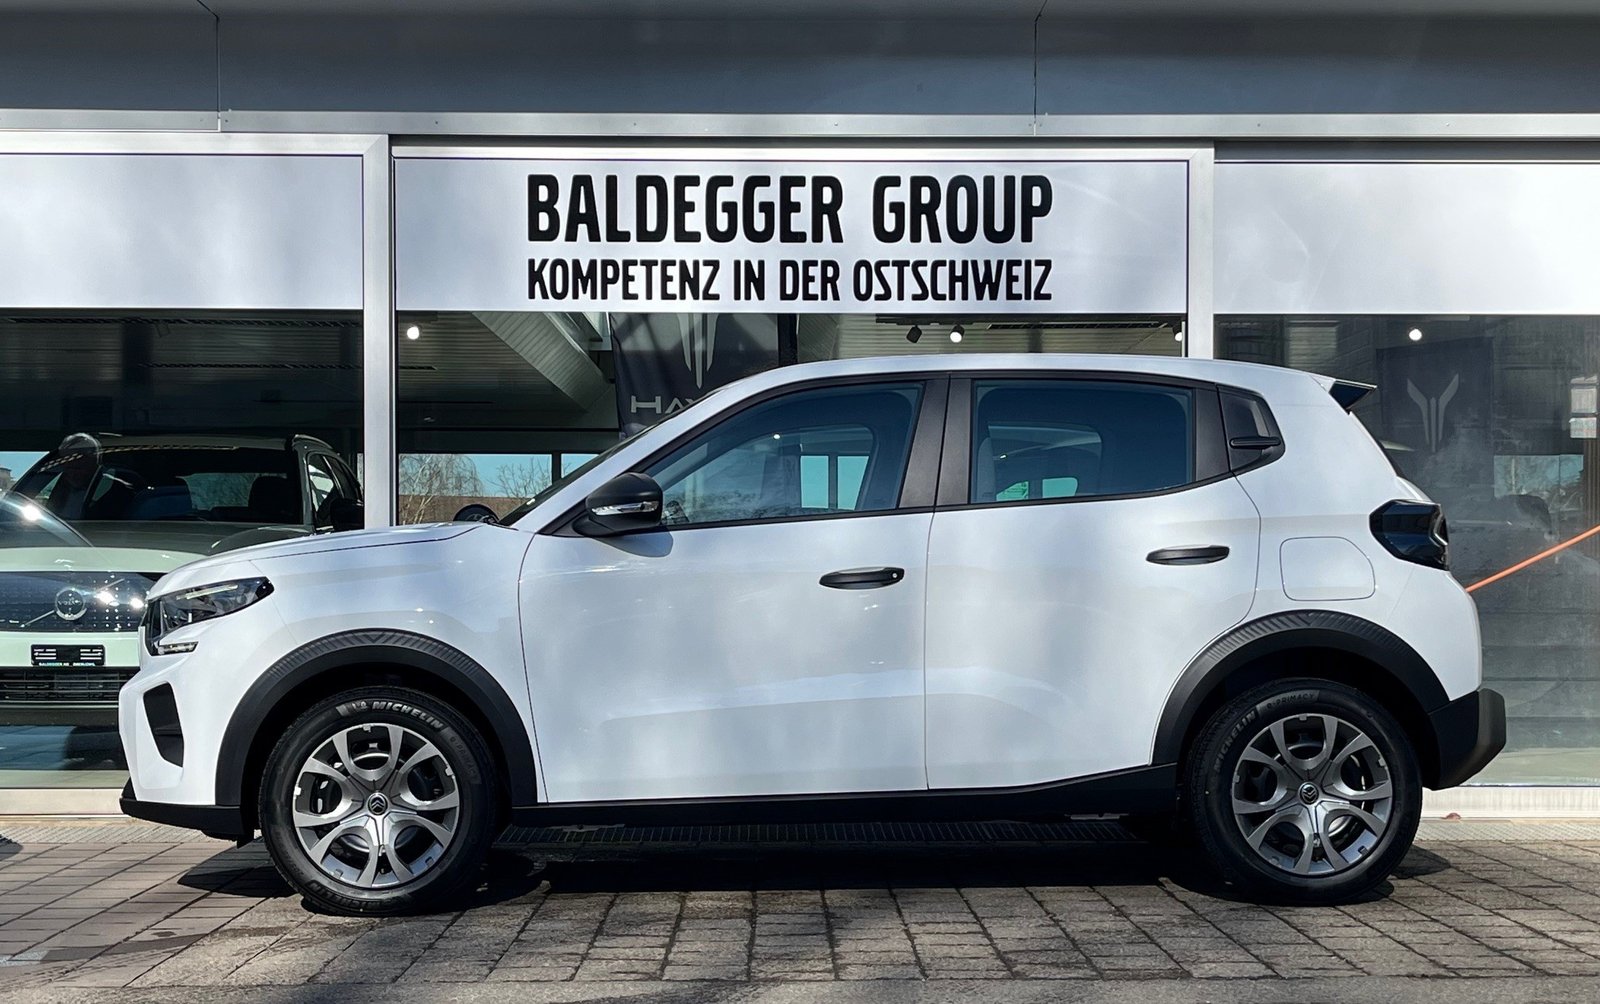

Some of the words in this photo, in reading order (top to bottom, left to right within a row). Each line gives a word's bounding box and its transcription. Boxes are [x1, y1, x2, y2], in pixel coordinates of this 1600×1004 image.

[528, 175, 843, 243] BALDEGGER
[873, 175, 1052, 243] GROUP
[528, 259, 720, 300] KOMPETENZ
[734, 260, 764, 300] IN
[780, 260, 840, 301] DER
[854, 260, 1051, 301] OSTSCHWEIZ
[372, 701, 444, 729] MICHELIN
[1214, 710, 1256, 772] MICHELIN
